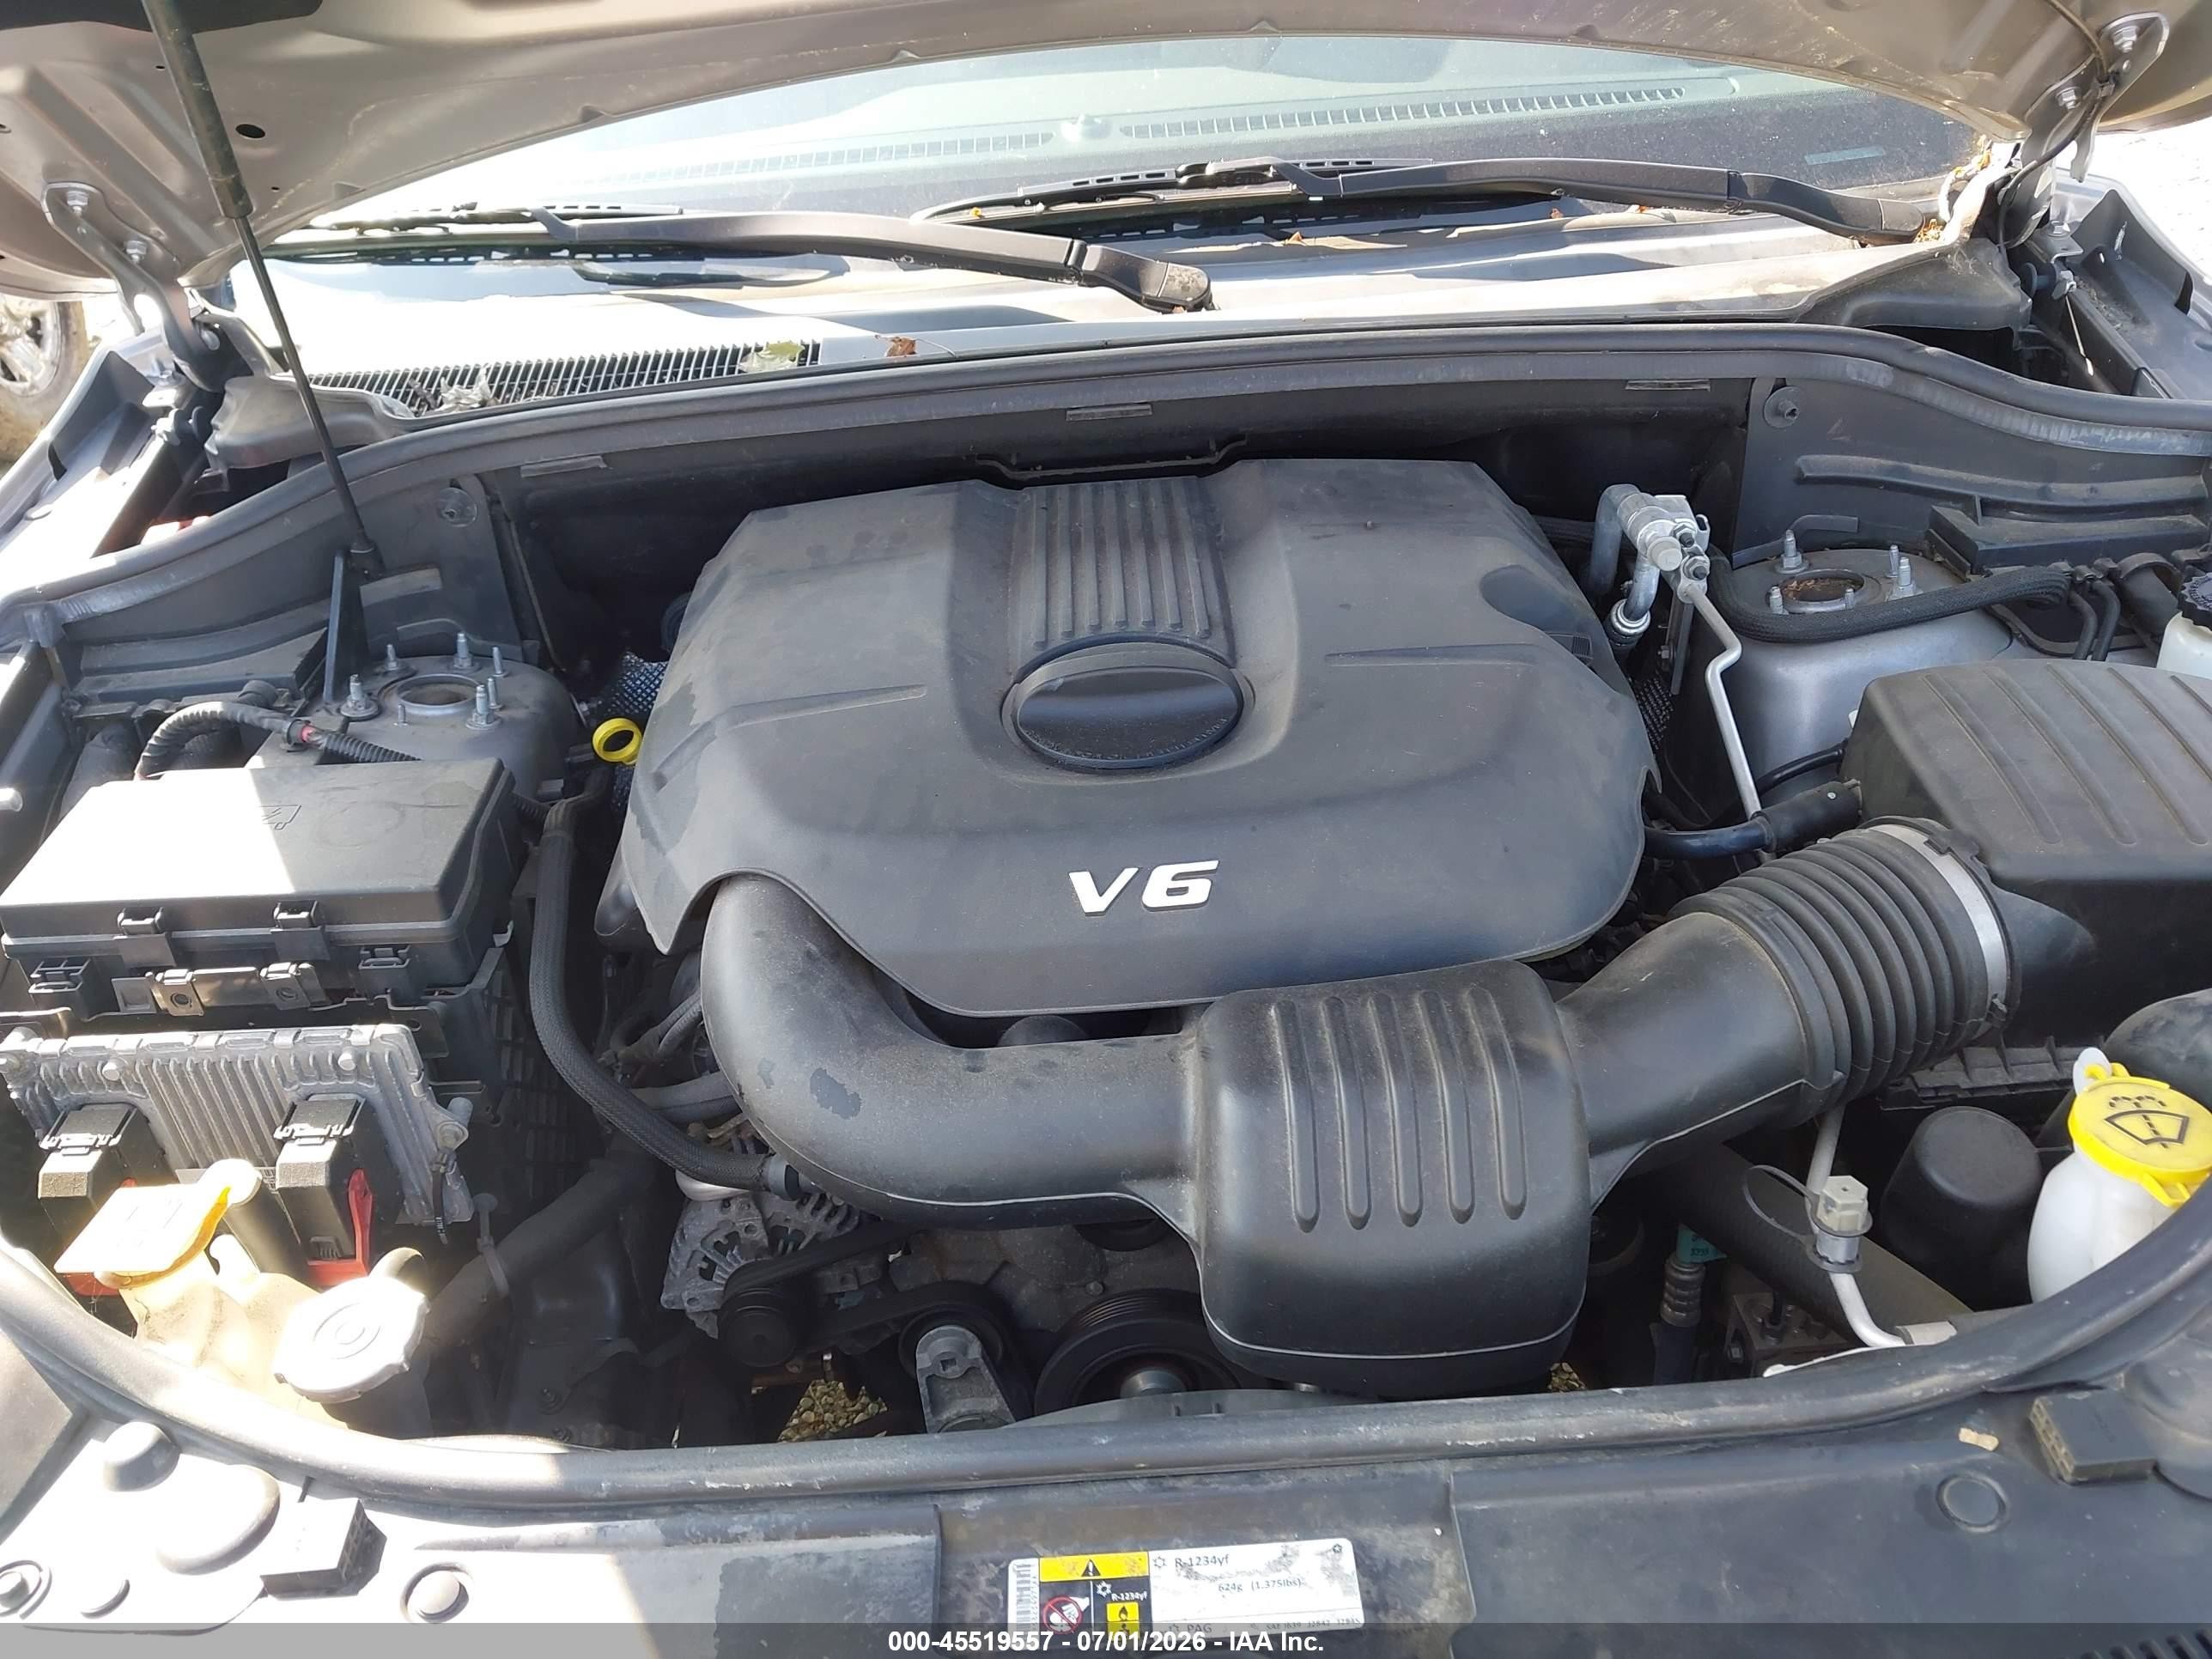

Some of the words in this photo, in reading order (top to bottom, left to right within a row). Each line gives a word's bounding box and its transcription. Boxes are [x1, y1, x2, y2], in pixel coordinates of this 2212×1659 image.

[1068, 860, 1220, 917] V6
[1174, 1553, 1231, 1568] R-1234yf
[1186, 1623, 1212, 1634] PAG
